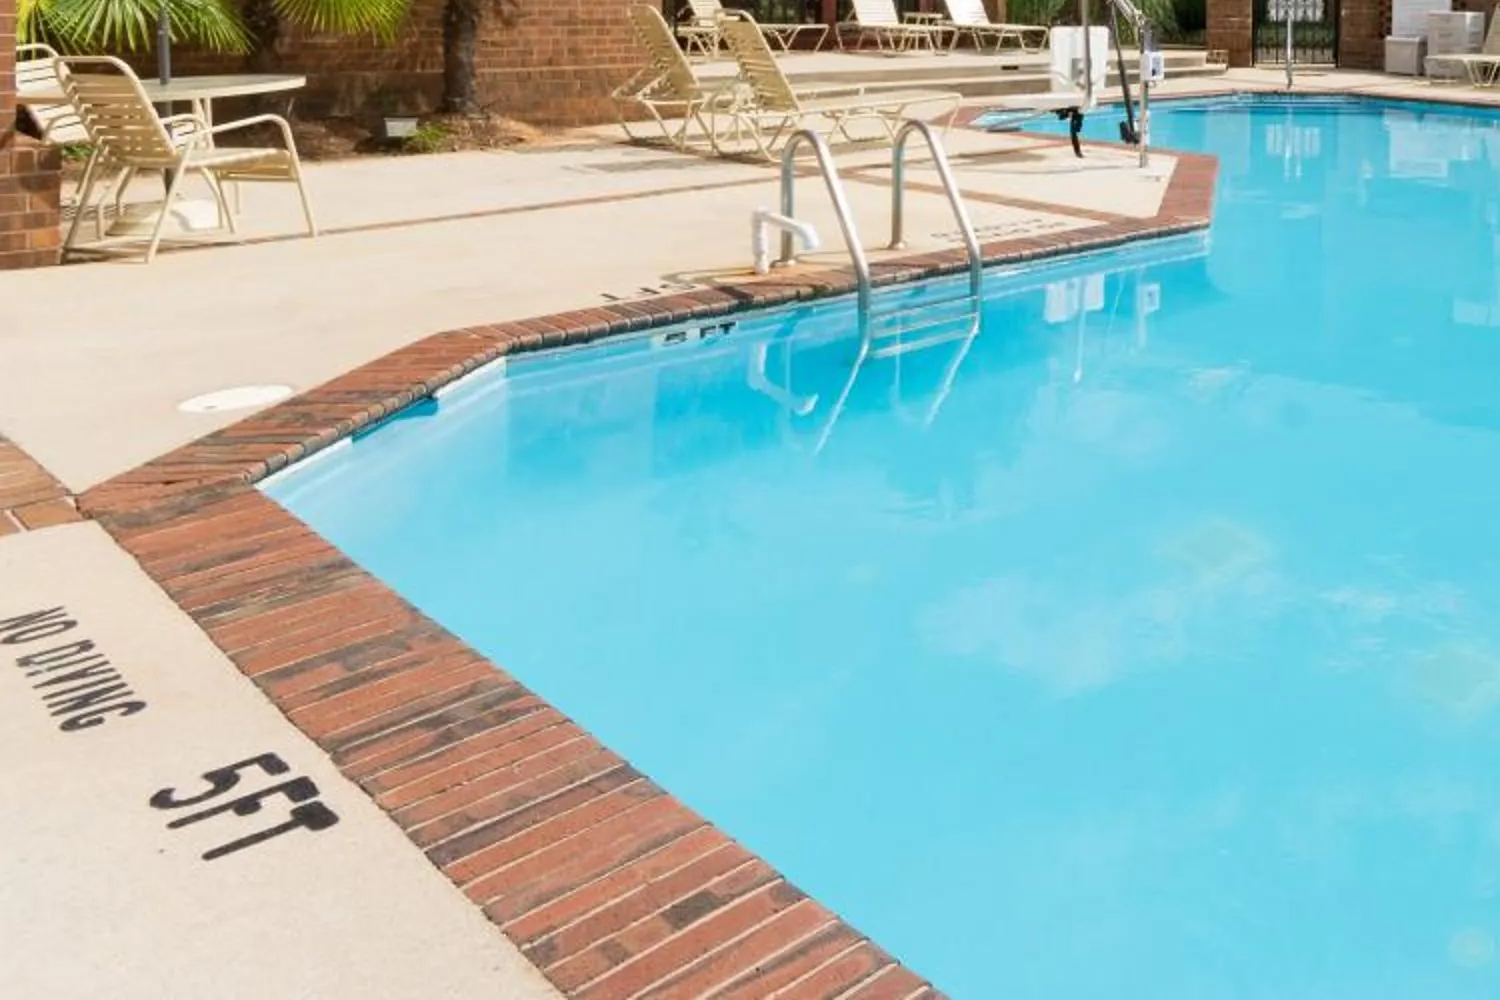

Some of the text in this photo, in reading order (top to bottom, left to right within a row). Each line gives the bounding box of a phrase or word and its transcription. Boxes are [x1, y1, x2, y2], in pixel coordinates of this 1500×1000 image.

[0, 605, 147, 732] NO DIVING
[149, 752, 340, 861] 5FT
